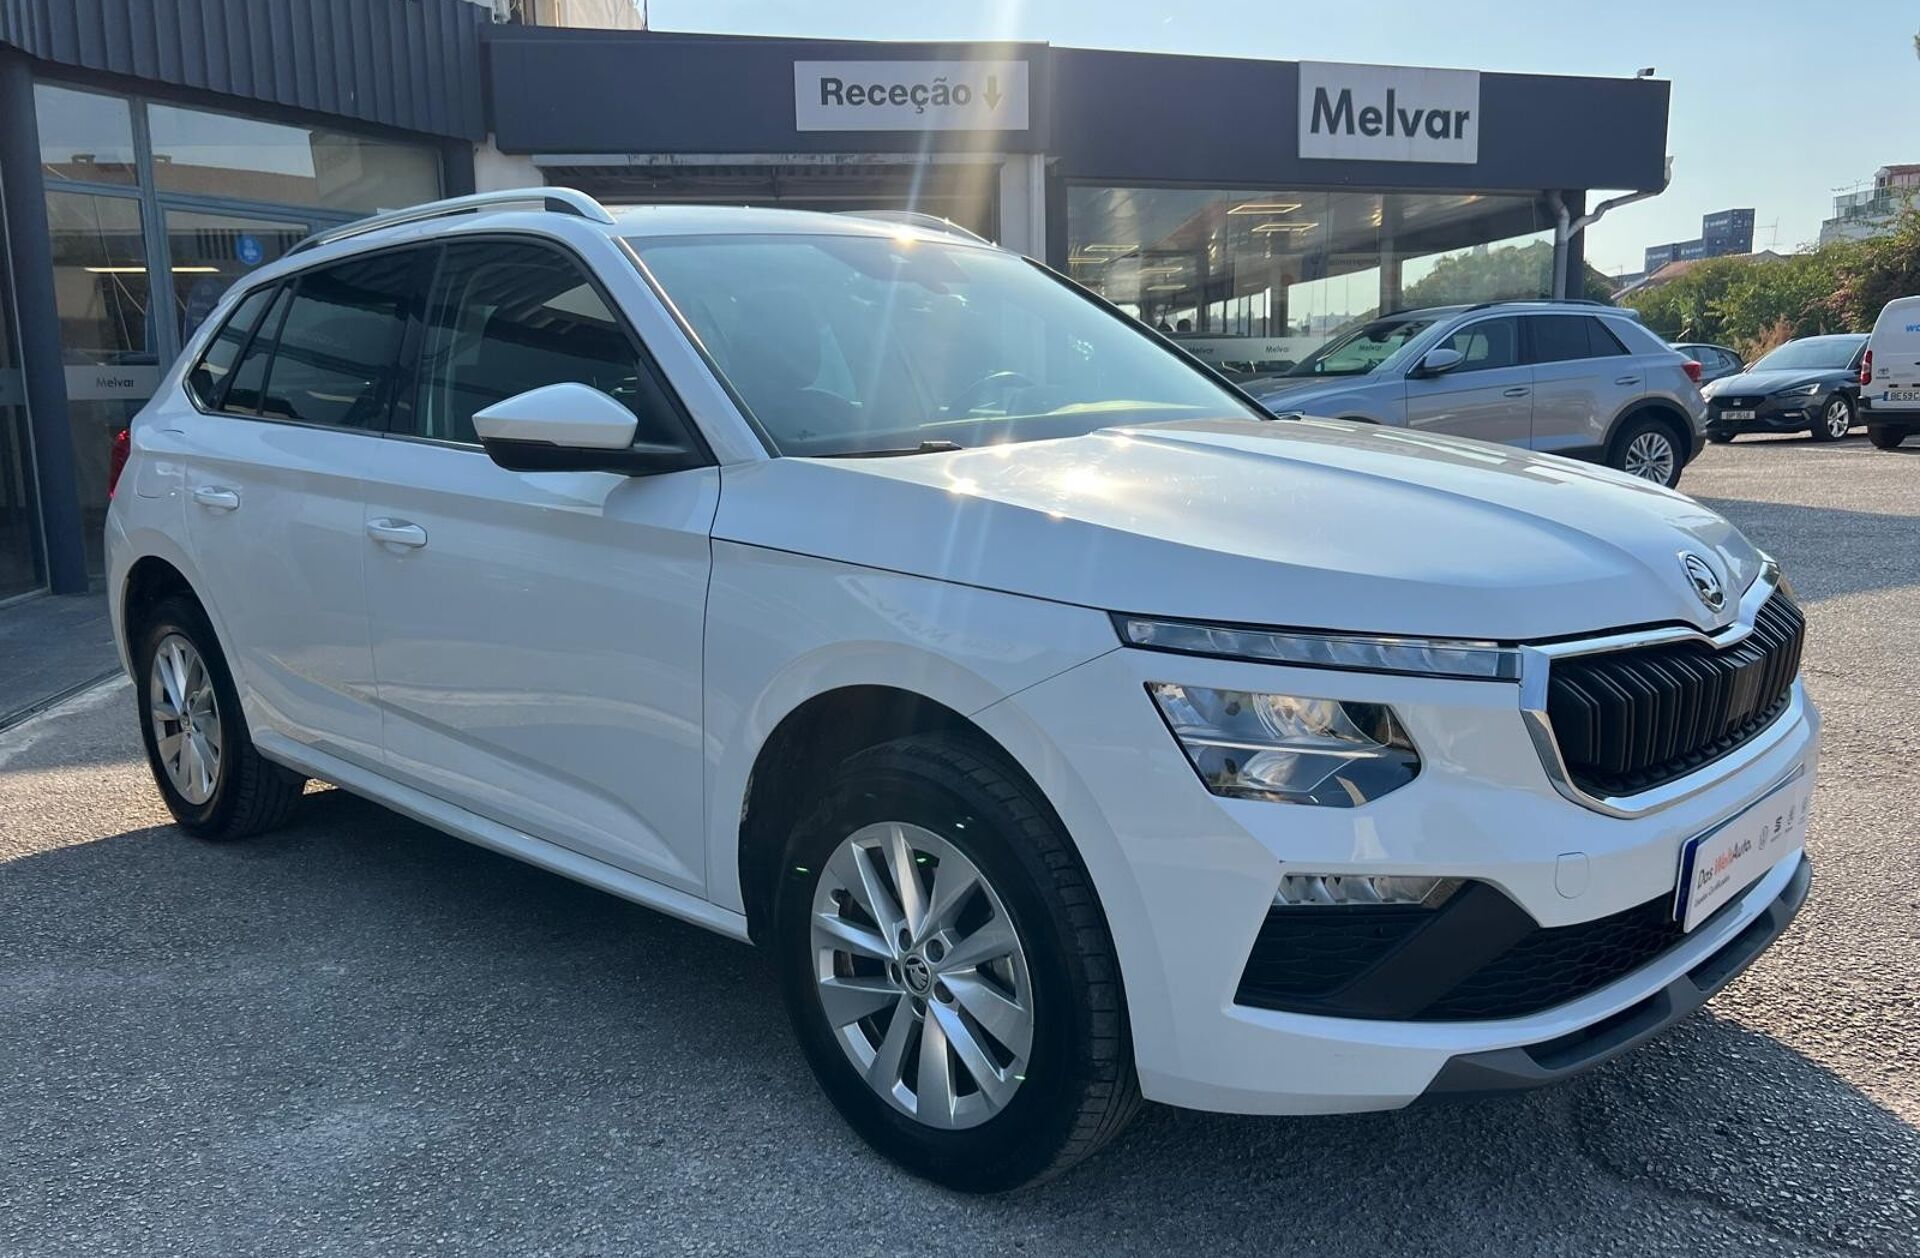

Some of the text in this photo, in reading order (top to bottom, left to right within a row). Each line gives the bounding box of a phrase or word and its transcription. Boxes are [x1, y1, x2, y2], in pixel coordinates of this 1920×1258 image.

[820, 76, 971, 114] Receção
[1310, 87, 1470, 139] Melvar
[1265, 344, 1290, 353] Melva
[96, 376, 134, 388] Melvar
[1697, 868, 1713, 889] Das
